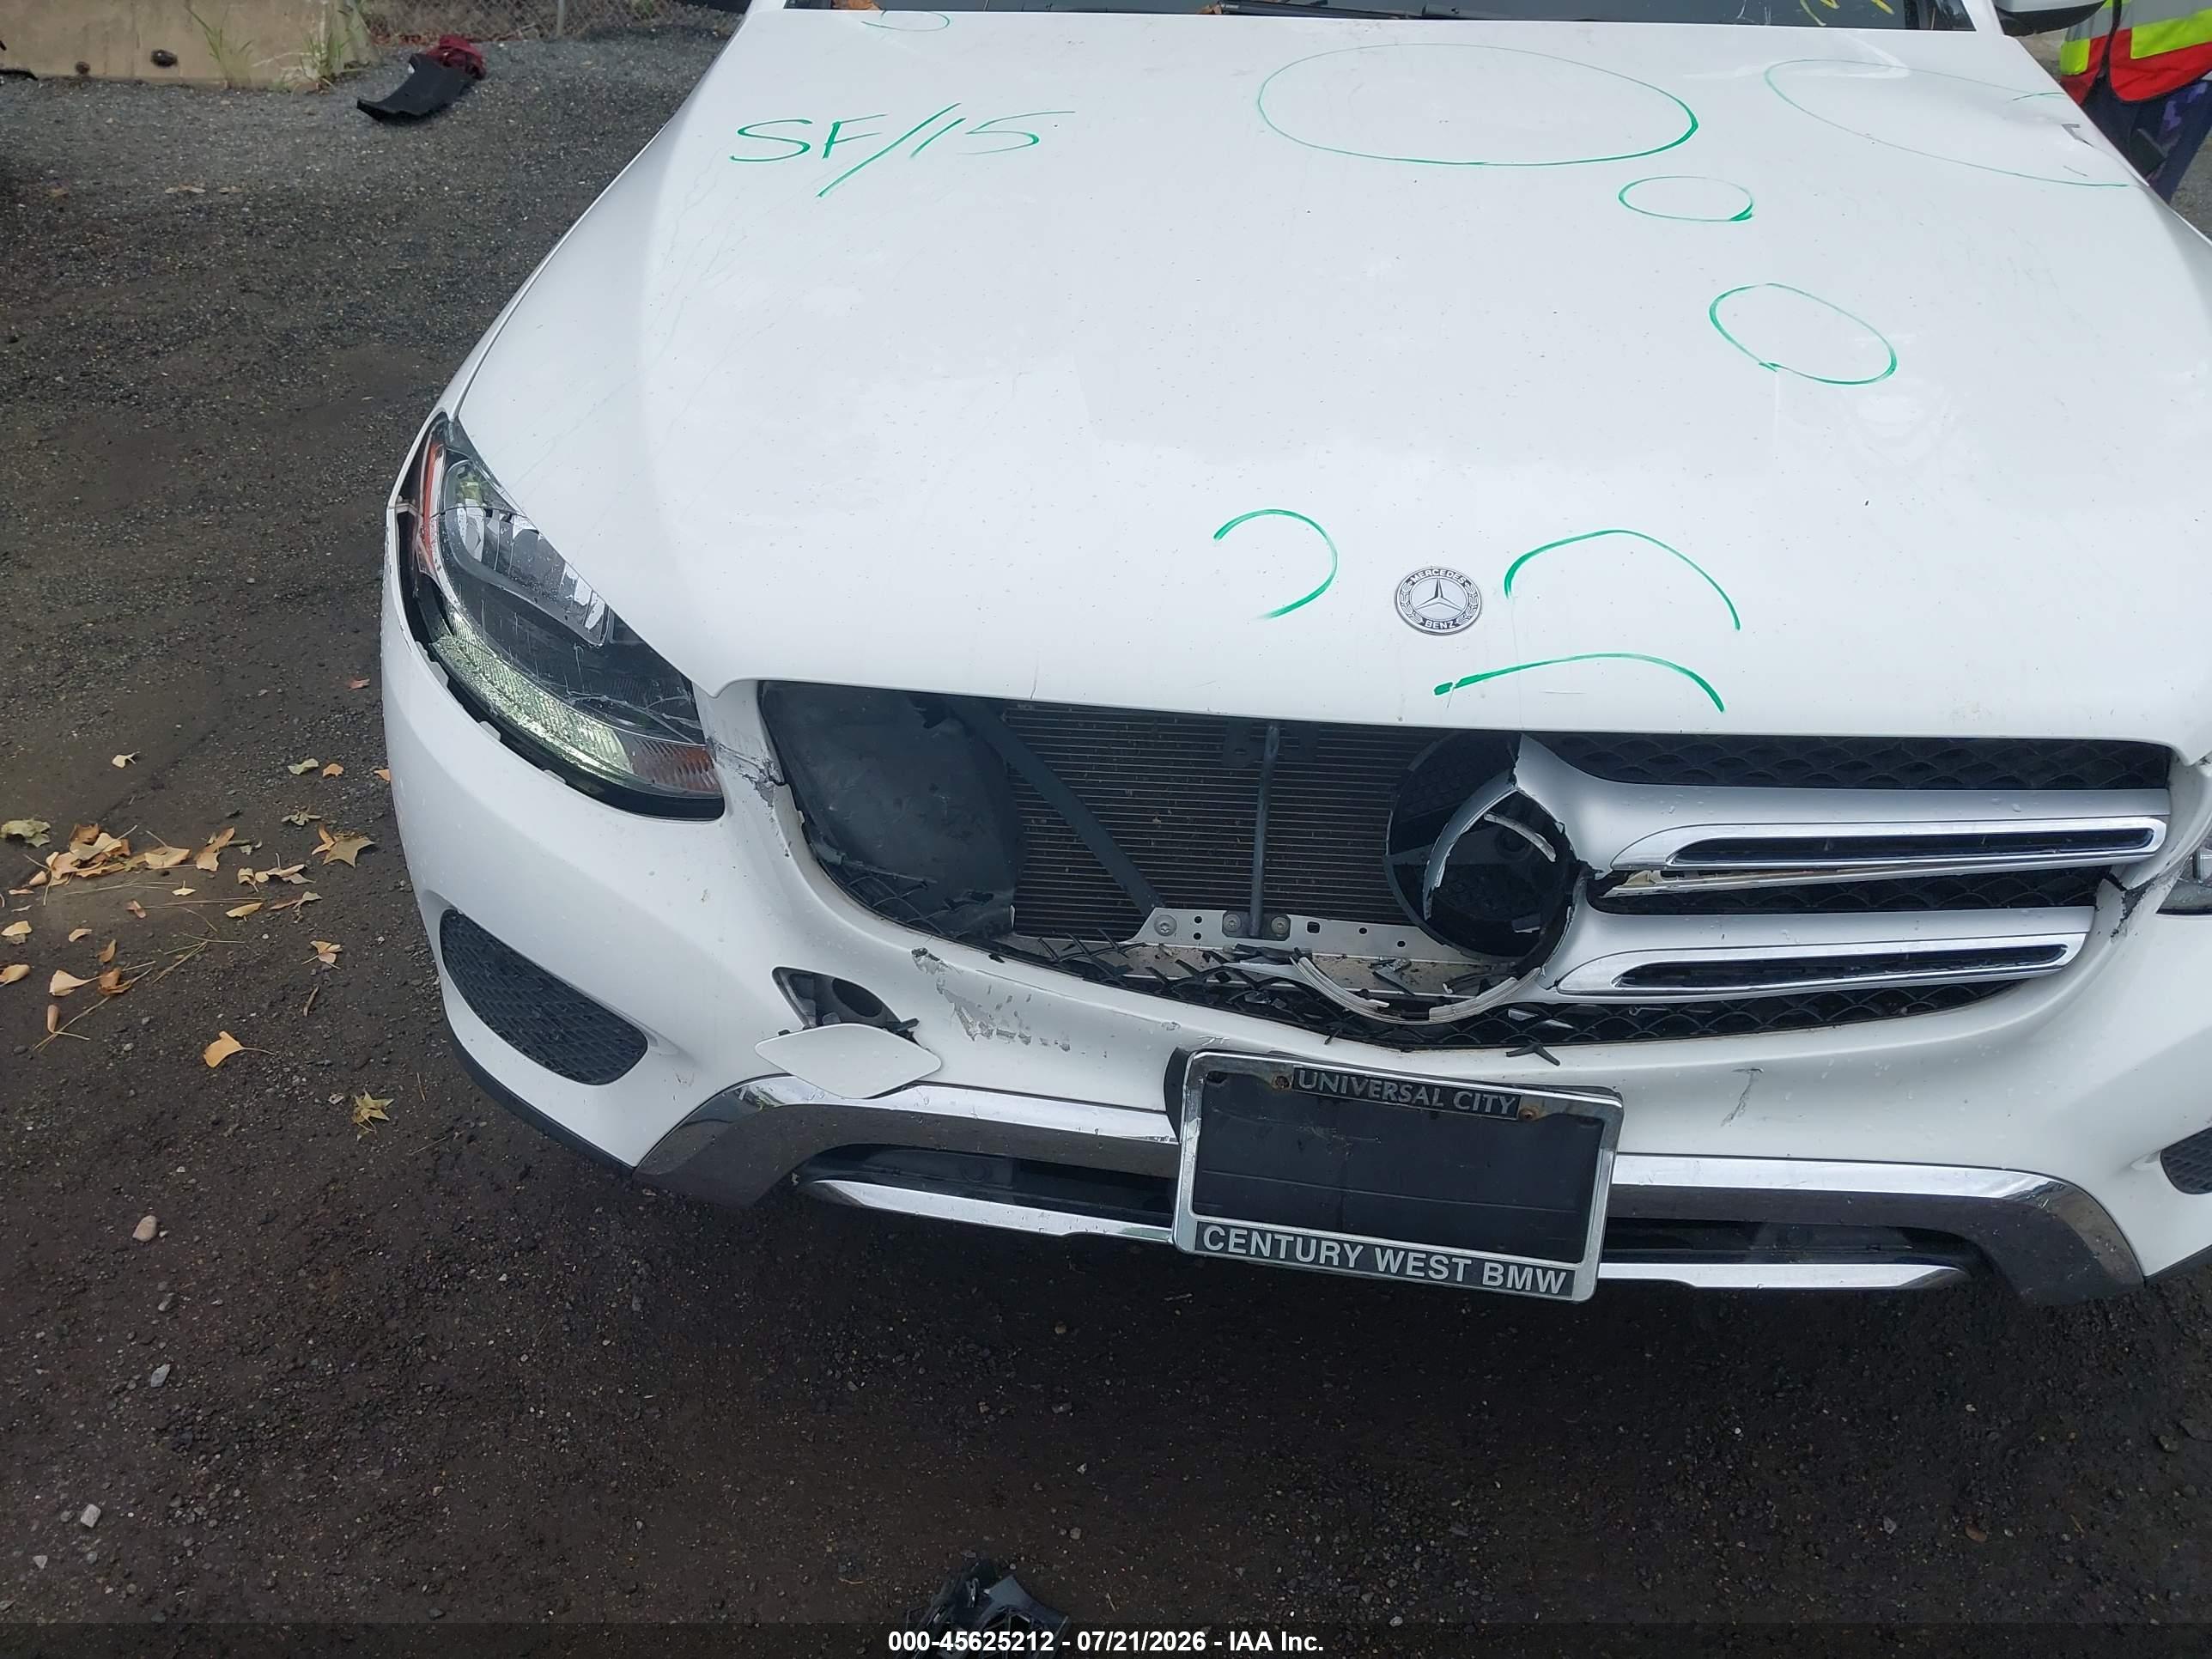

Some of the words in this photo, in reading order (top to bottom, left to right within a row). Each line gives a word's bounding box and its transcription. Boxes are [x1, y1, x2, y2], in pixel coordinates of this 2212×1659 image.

[1410, 568, 1467, 585] MERCEDES
[1425, 619, 1455, 629] BENZ
[1297, 1068, 1444, 1109] UNIVERSAL
[1453, 1090, 1516, 1115] CITY
[1202, 1224, 1364, 1268] CENTURY
[1374, 1248, 1475, 1282] WEST
[1482, 1262, 1566, 1295] BMW
